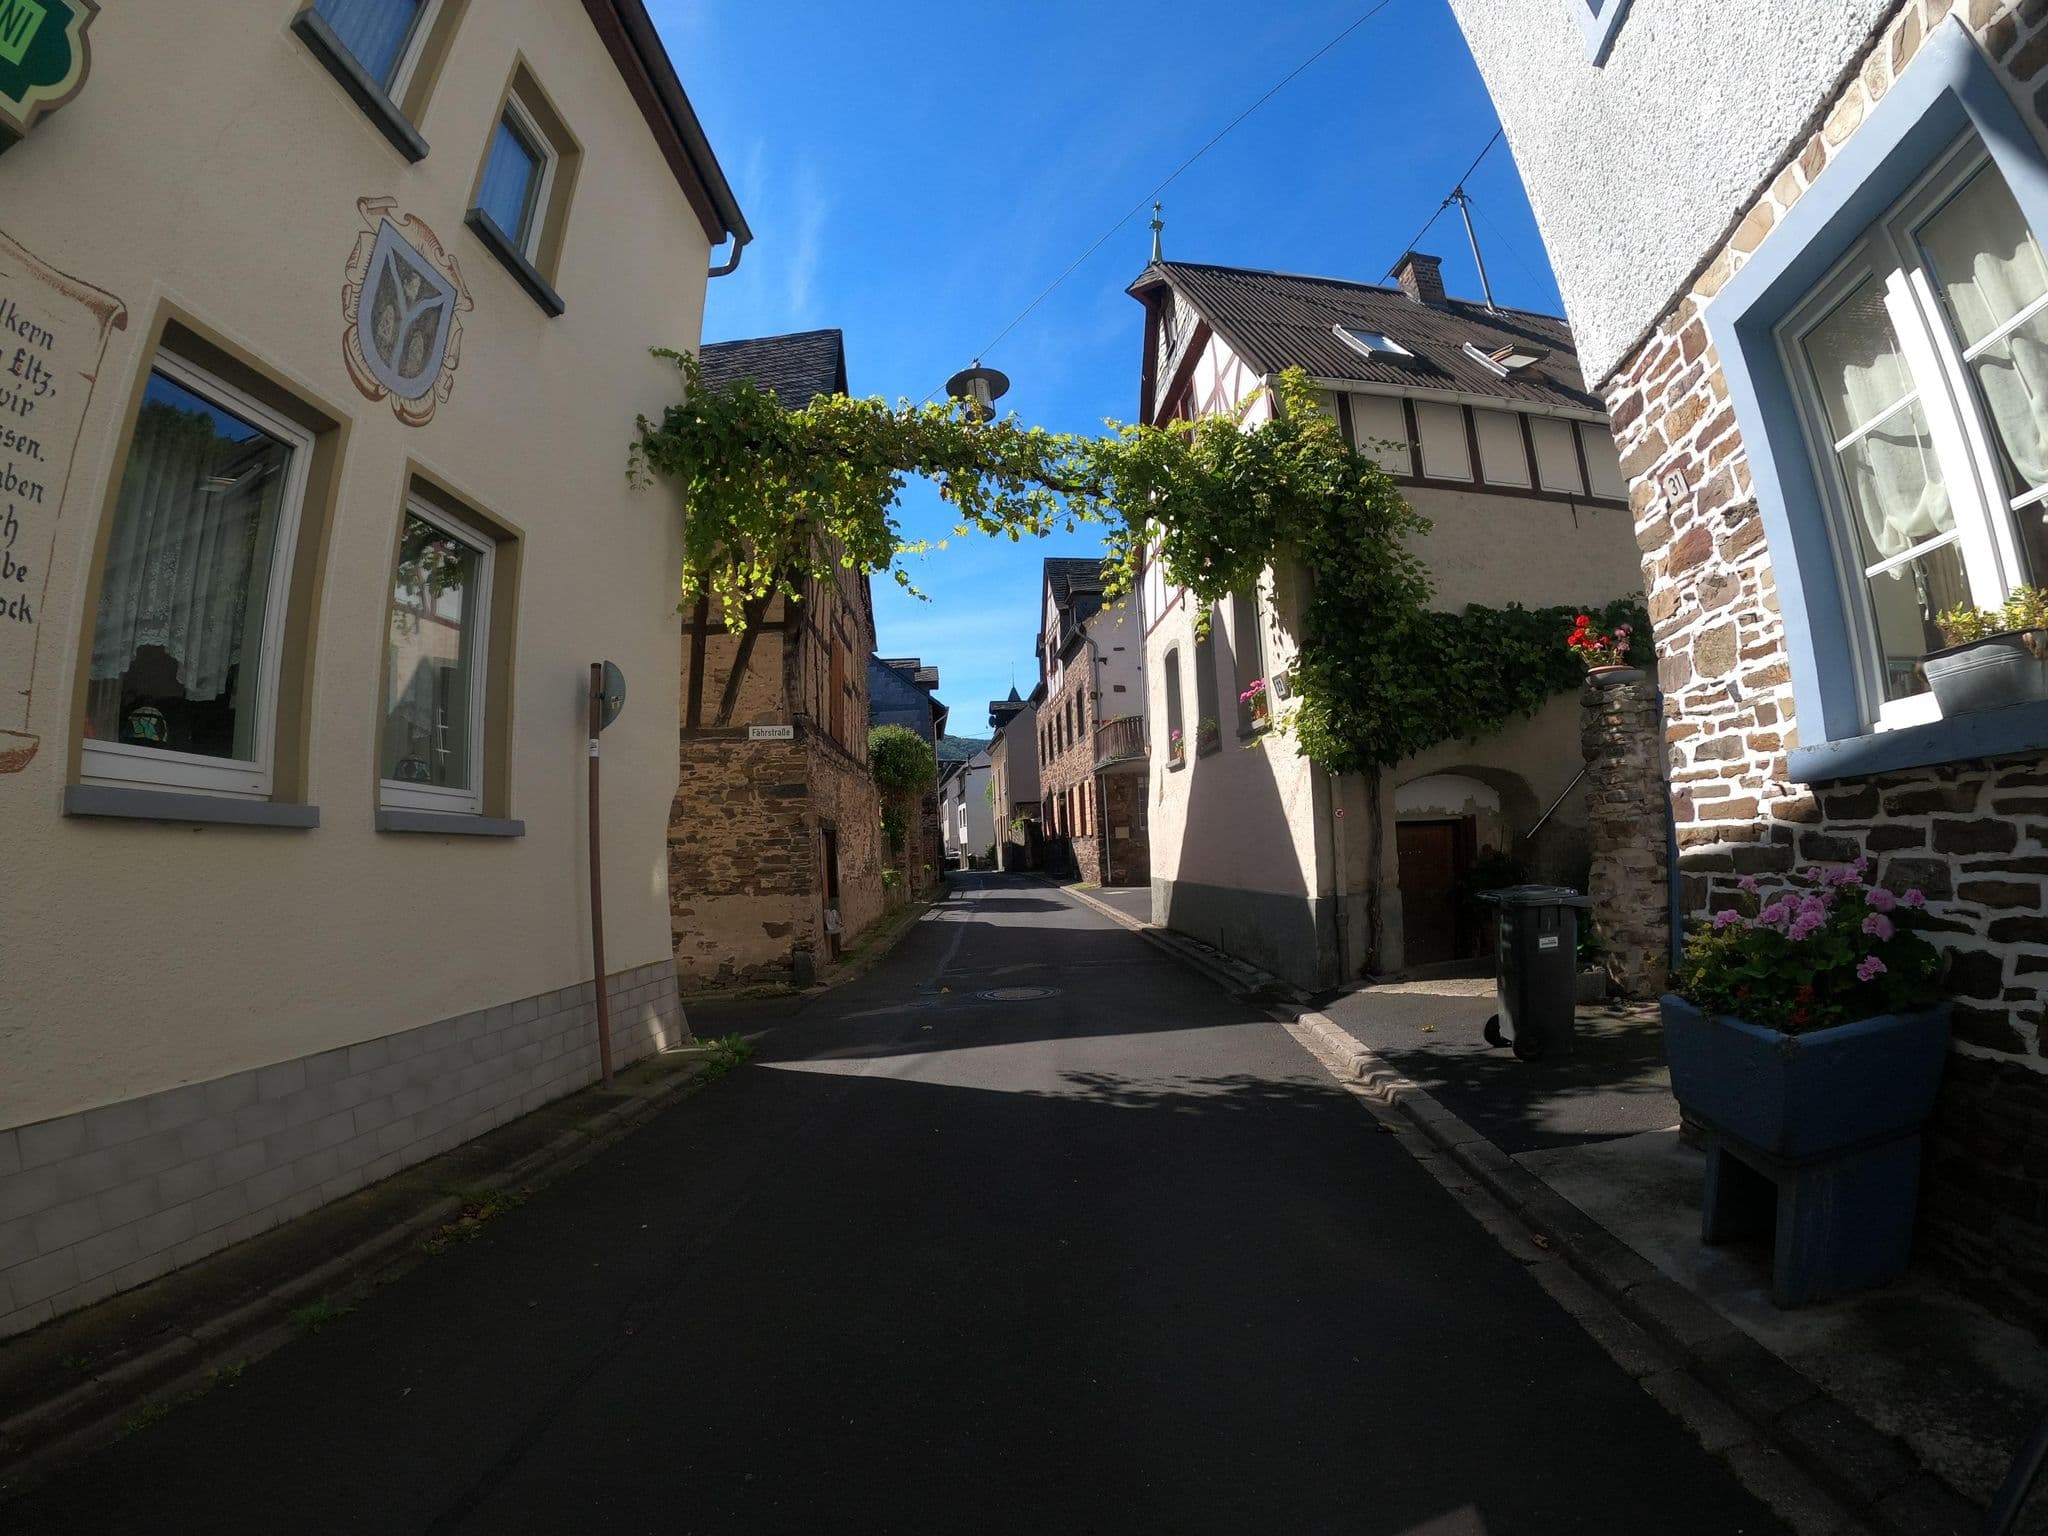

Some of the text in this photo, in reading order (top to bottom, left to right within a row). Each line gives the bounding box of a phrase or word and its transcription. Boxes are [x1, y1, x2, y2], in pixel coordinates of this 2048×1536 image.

[7, 348, 56, 397] Eltz,
[0, 425, 45, 462] sen.
[0, 463, 43, 503] ben
[1668, 474, 1684, 496] 31
